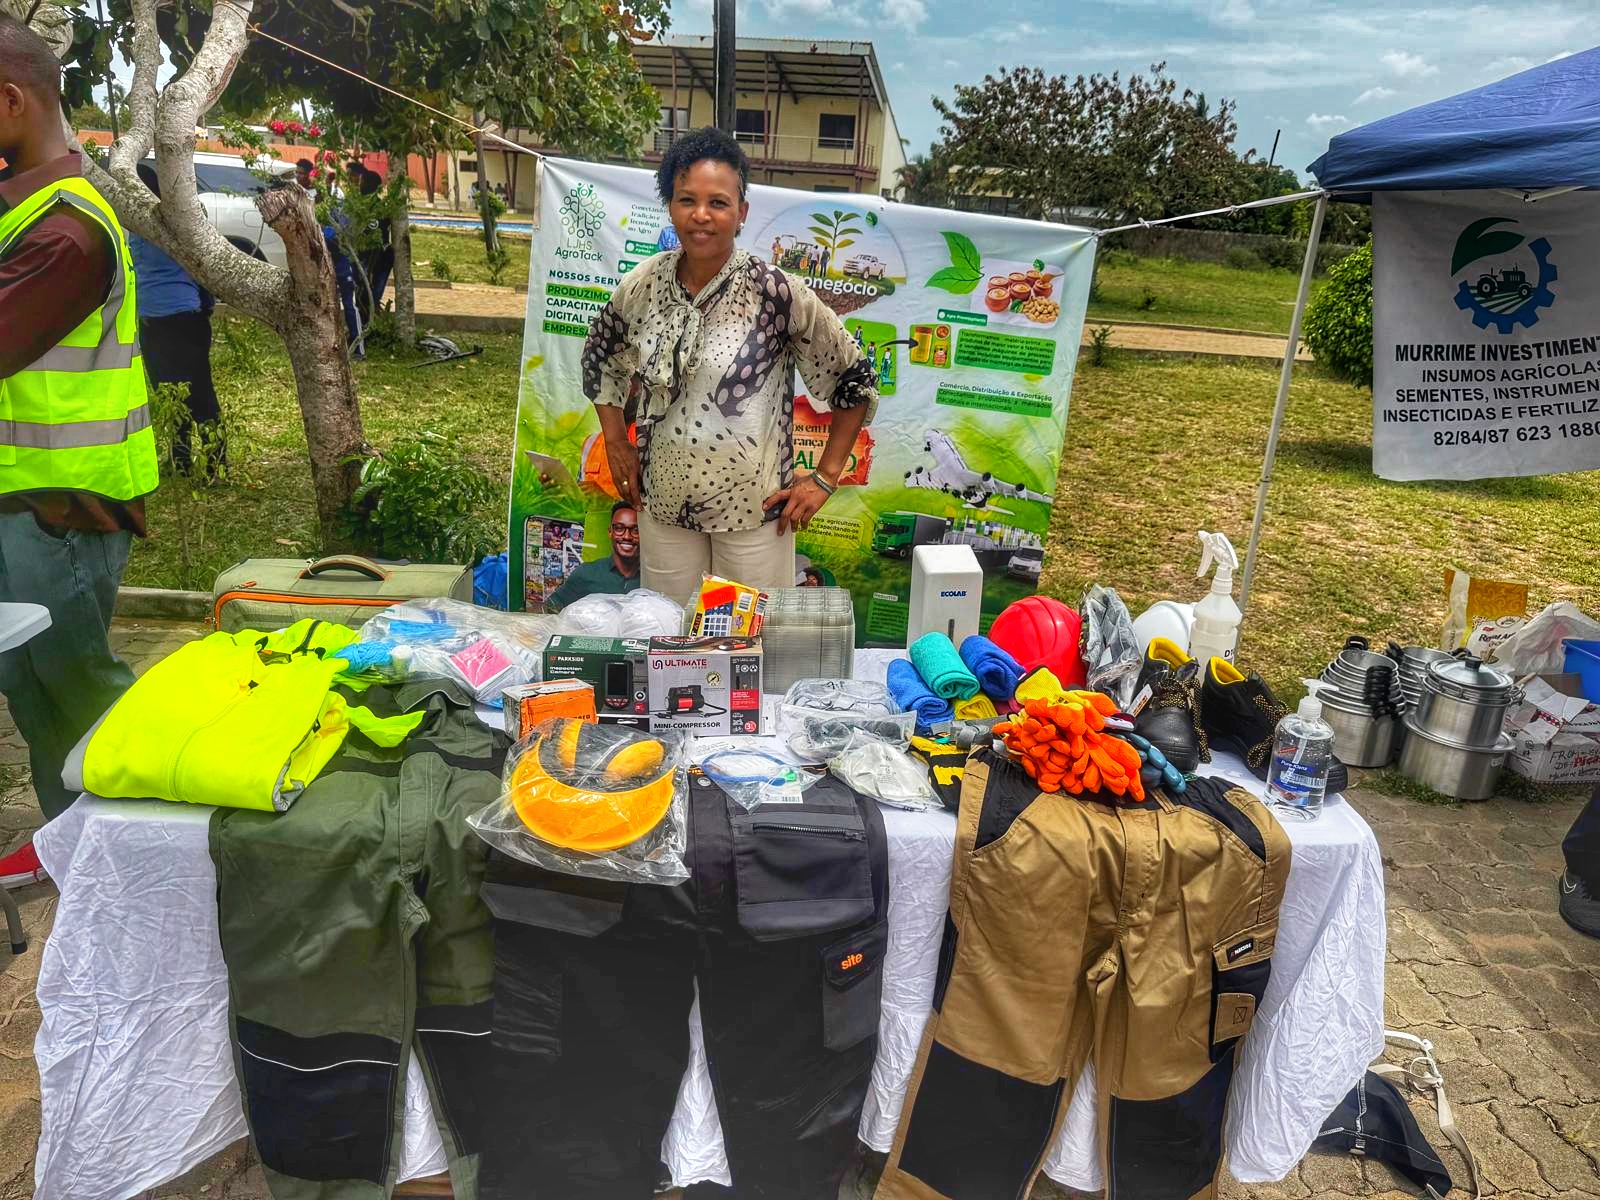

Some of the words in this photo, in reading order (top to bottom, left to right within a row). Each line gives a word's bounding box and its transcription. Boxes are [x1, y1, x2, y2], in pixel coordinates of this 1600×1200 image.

[567, 237, 593, 250] LJHS
[554, 246, 604, 262] AgroTack
[549, 270, 591, 282] NOSSOS
[547, 284, 611, 301] PRODUZIMO
[545, 310, 585, 324] DIGITAL
[1395, 344, 1476, 362] MURRIME
[1422, 369, 1496, 382] INSUMOS
[972, 386, 1010, 396] Distribuição
[1016, 391, 1053, 402] Exportação
[1396, 388, 1489, 403] SEMENTES,
[1493, 379, 1600, 399] INSTRUMEN
[1383, 407, 1497, 422] INSECTICIDAS
[1501, 407, 1513, 419] E
[1517, 399, 1600, 418] FERTILIZ
[805, 425, 820, 433] em
[1433, 428, 1509, 446] 82/84/87
[1516, 425, 1551, 442] 623
[940, 590, 967, 598] ECOLAB
[665, 658, 708, 667] ULTIMATE
[653, 721, 721, 729] MINI-COMPRESSOR
[841, 952, 863, 970] site
